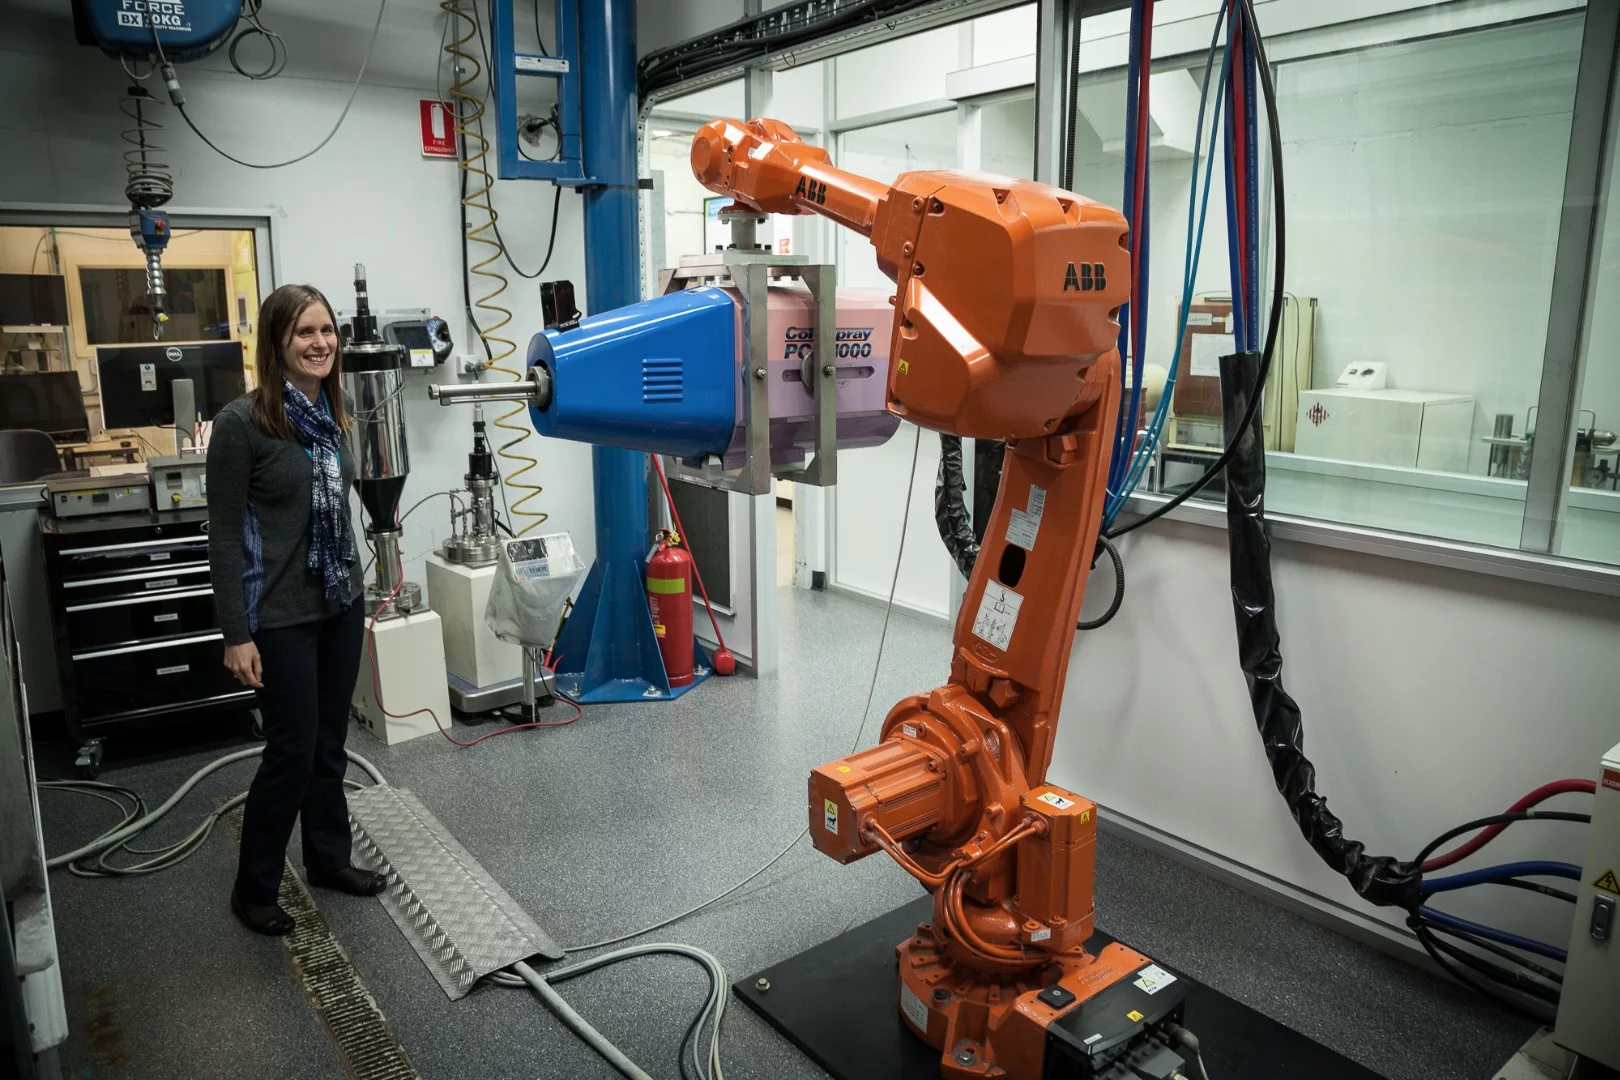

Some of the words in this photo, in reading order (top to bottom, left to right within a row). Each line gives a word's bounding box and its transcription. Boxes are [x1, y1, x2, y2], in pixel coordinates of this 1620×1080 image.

[122, 0, 185, 15] FORCE
[121, 14, 140, 25] BX
[795, 175, 827, 206] ABB
[1063, 262, 1107, 292] ABB
